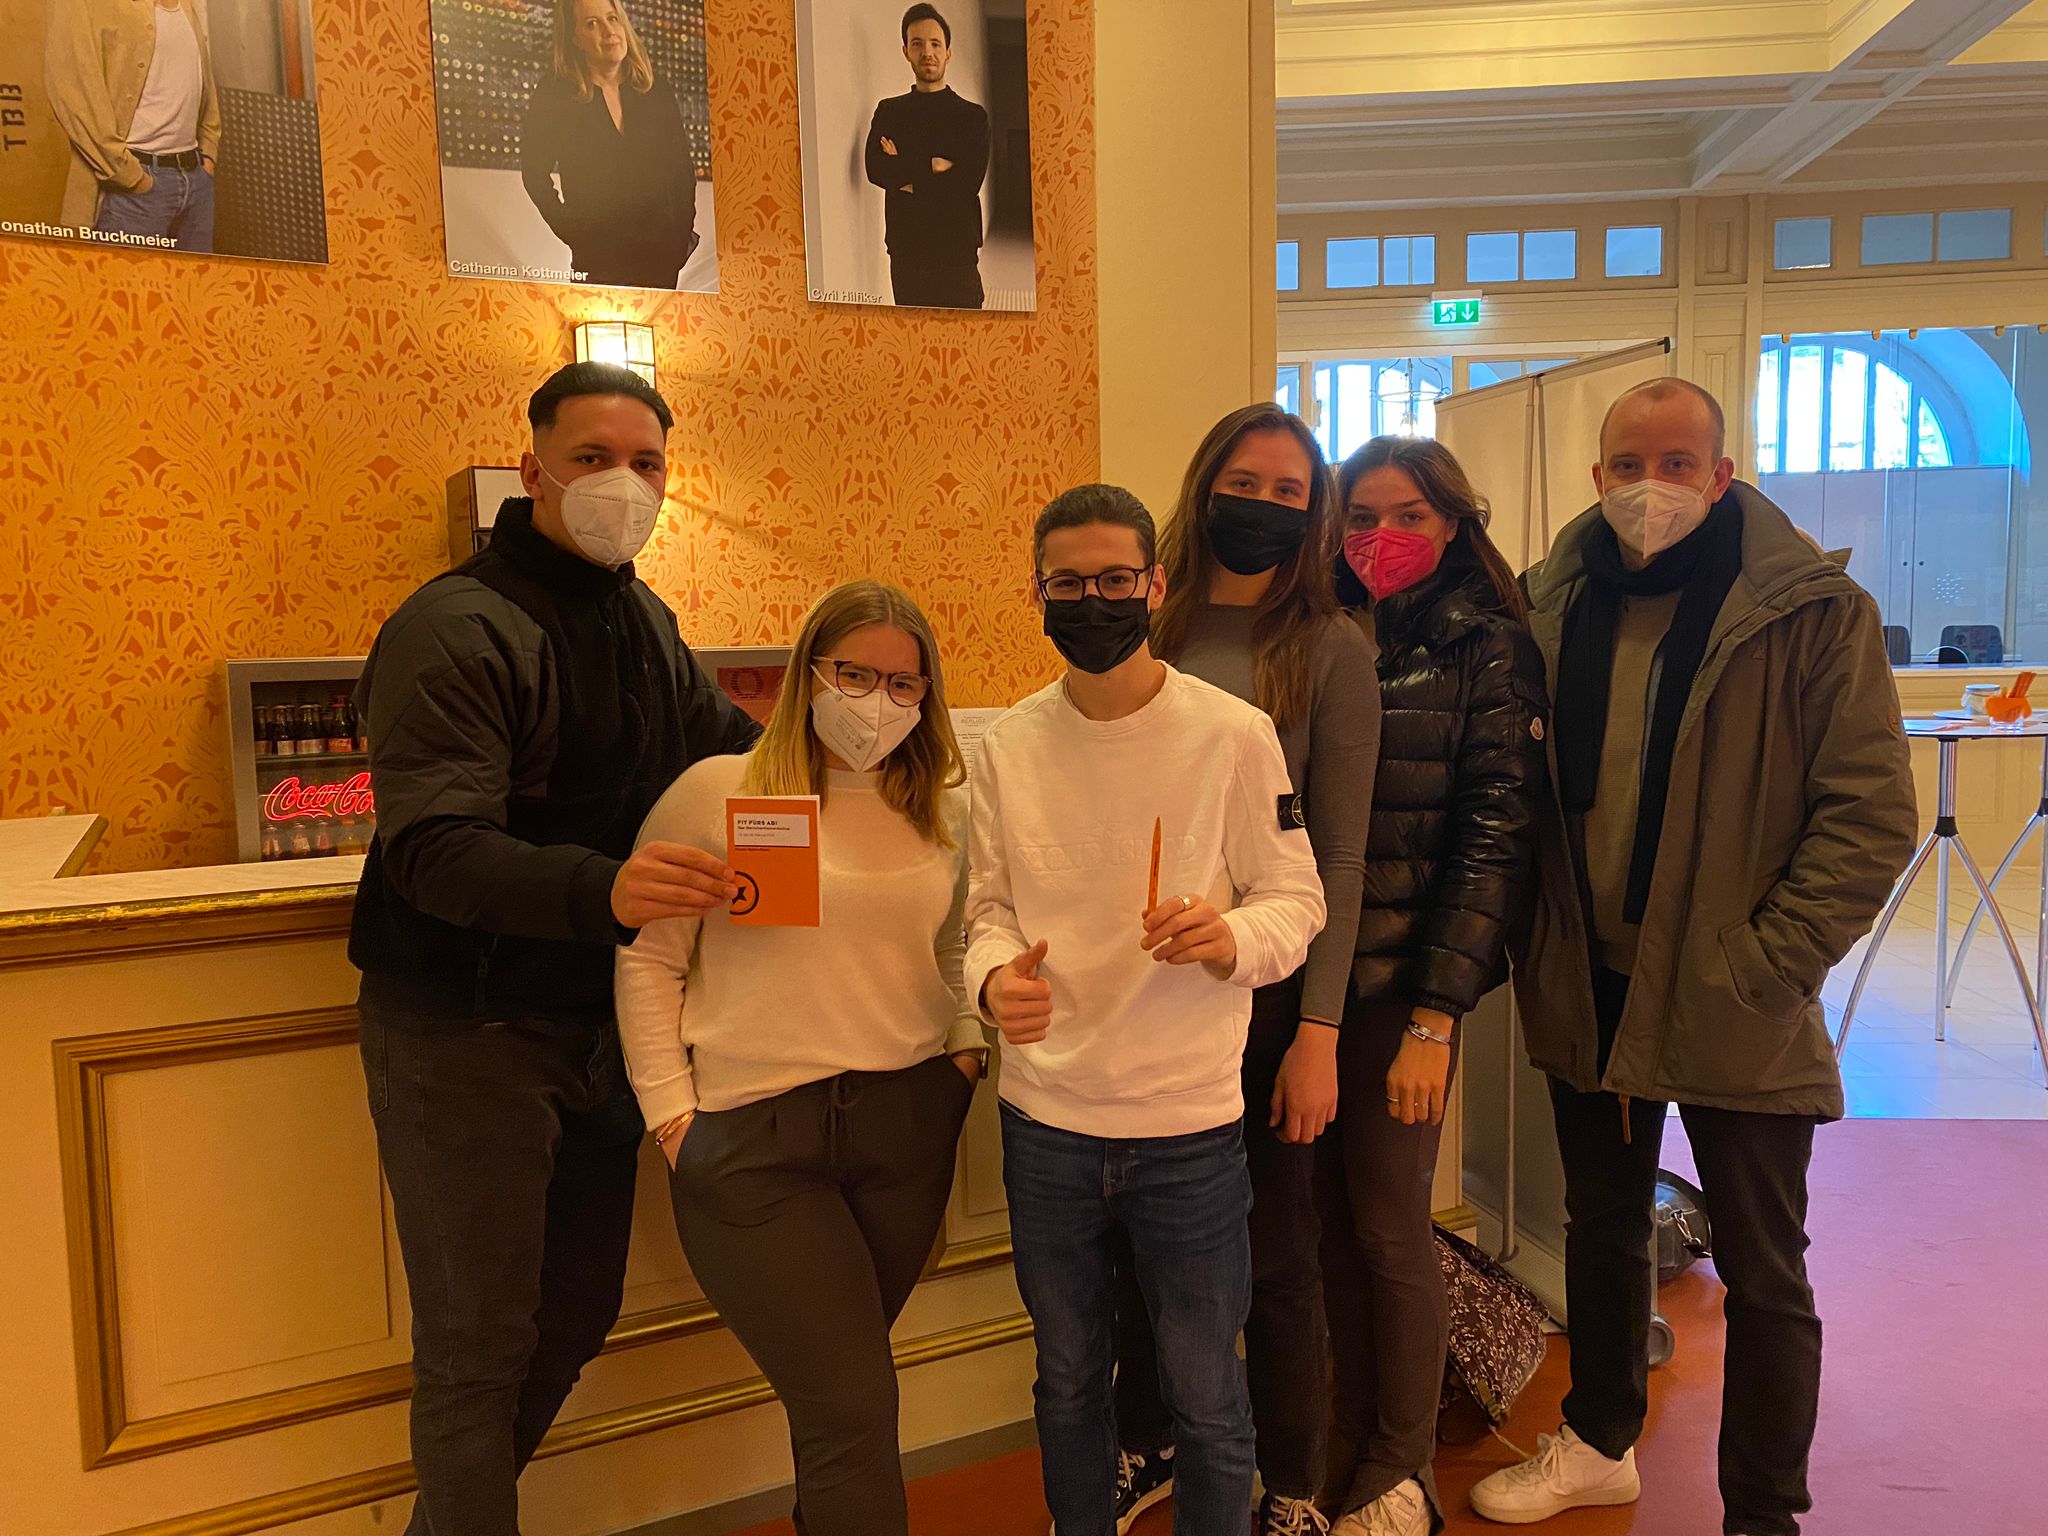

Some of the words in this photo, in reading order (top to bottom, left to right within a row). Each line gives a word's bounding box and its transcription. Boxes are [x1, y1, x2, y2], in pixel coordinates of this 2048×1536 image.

[0, 83, 28, 151] TBB
[1, 221, 74, 239] onathan
[79, 226, 178, 249] Bruckmeier
[450, 260, 519, 277] Catharina
[521, 265, 589, 281] Kottmeier
[812, 288, 839, 302] Cyril
[264, 772, 376, 821] Coca-Co
